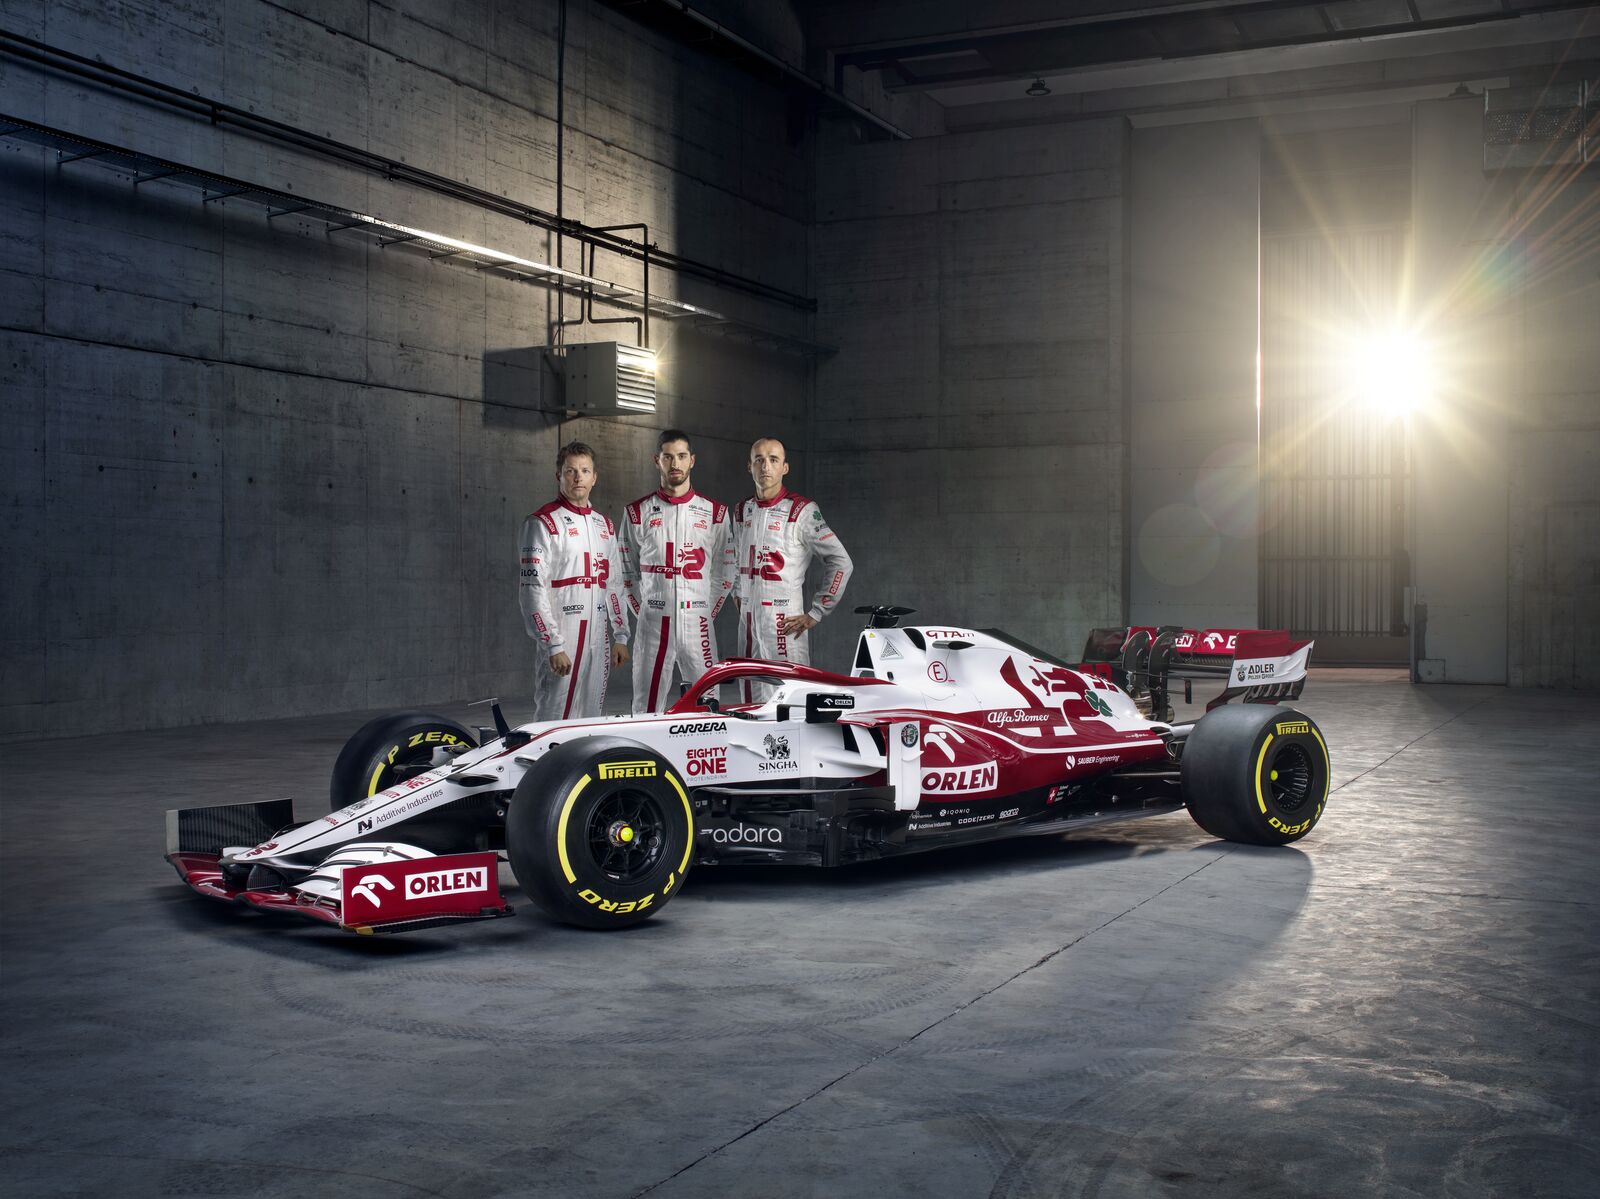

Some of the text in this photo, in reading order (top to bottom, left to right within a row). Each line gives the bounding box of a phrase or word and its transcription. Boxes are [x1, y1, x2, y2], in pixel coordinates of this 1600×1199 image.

[699, 616, 713, 668] ANTONIO
[1248, 664, 1274, 675] ADLER
[669, 722, 727, 734] CARRERA
[987, 709, 1049, 728] Alfa Romeo
[1276, 721, 1309, 735] PIRELLI
[387, 745, 399, 765] P
[686, 746, 728, 759] EIGHTY
[1077, 756, 1096, 765] SAUBER
[598, 760, 656, 780] PIRELLI
[686, 757, 727, 776] ONE
[758, 761, 798, 771] SINGHA
[922, 766, 995, 791] ORLEN
[376, 805, 407, 824] Additive
[407, 788, 444, 810] Industries
[712, 822, 782, 843] adara
[1268, 816, 1311, 835] ZERO
[410, 871, 482, 895] ORLEN
[578, 872, 675, 914] P ZERO
